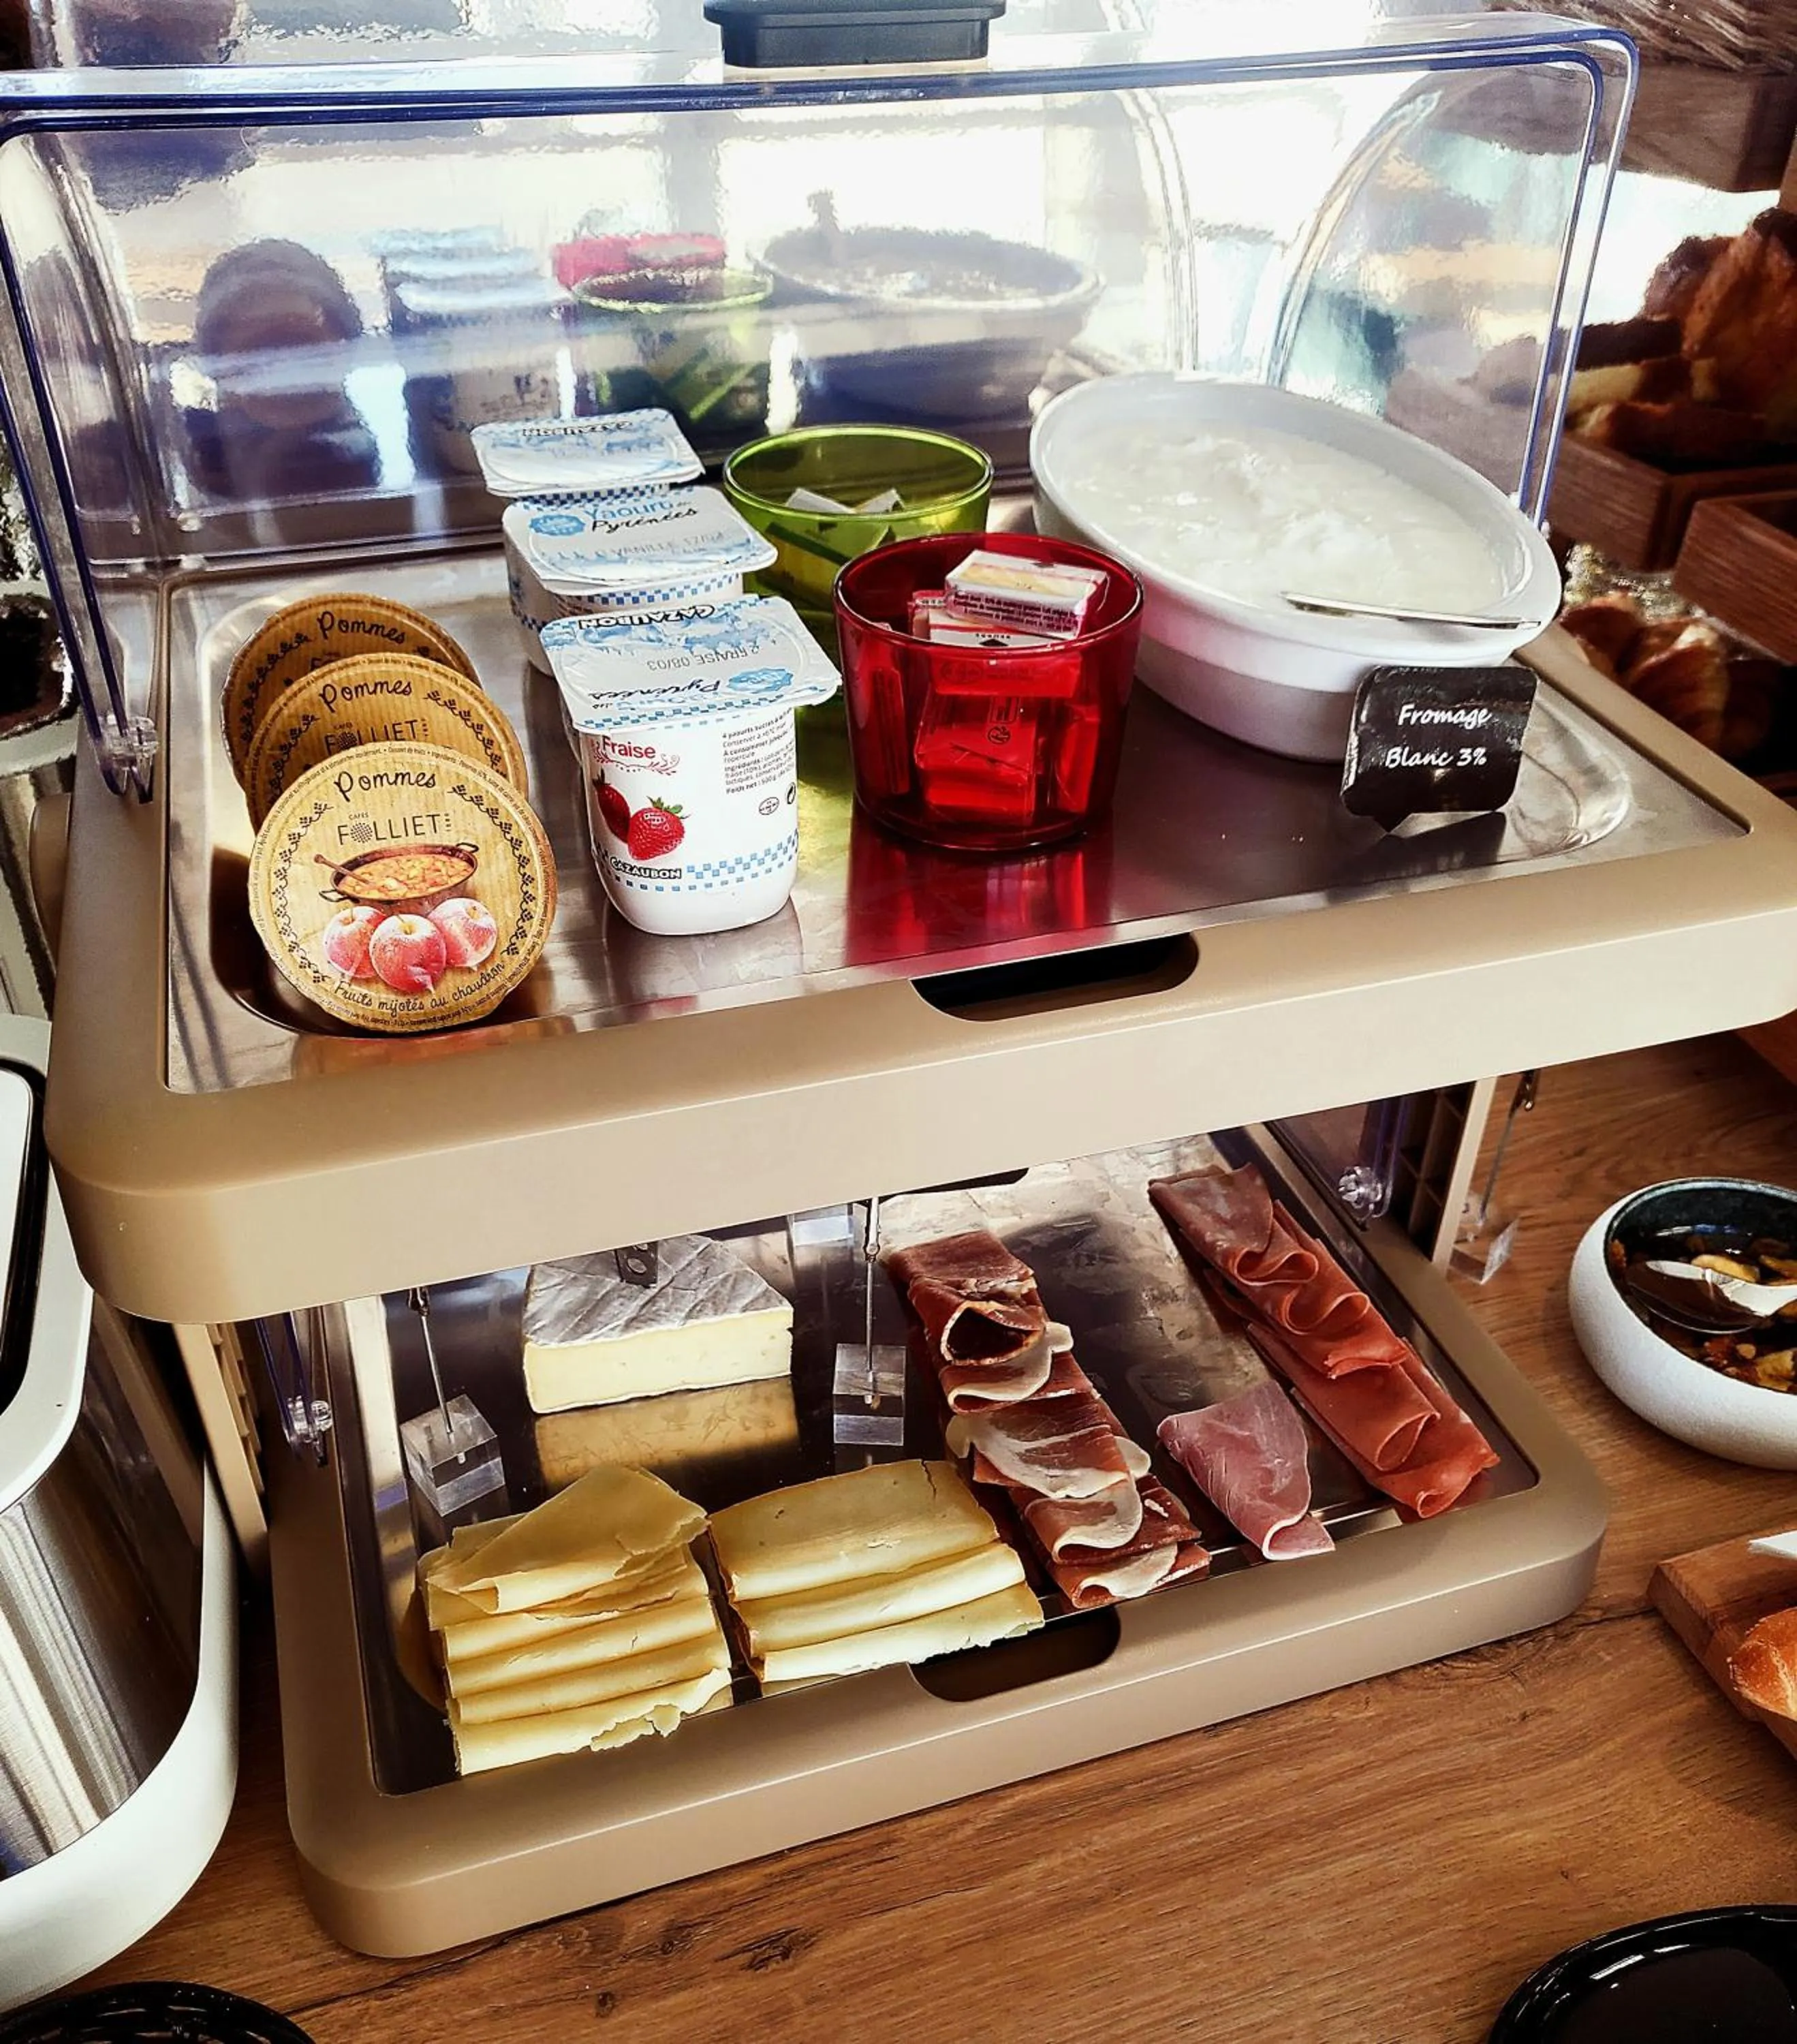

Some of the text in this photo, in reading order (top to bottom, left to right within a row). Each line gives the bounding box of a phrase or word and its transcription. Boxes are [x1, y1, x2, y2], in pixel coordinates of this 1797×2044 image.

[317, 610, 405, 644] Pommes
[578, 604, 716, 630] CAZAUBON
[646, 655, 691, 671] 08/03
[696, 646, 748, 665] FRAISE
[319, 680, 412, 713] Pommes
[1398, 703, 1493, 730] Fromage
[602, 735, 656, 758] Fraise
[1385, 747, 1488, 769] Blanc 3%
[334, 771, 436, 802] Pommes
[338, 814, 440, 845] FOLLIET
[610, 856, 682, 879] CAZAUBON
[334, 981, 372, 1006] Fruits
[378, 997, 424, 1017] mijotés
[430, 997, 449, 1008] au
[452, 963, 505, 1000] chaudron
